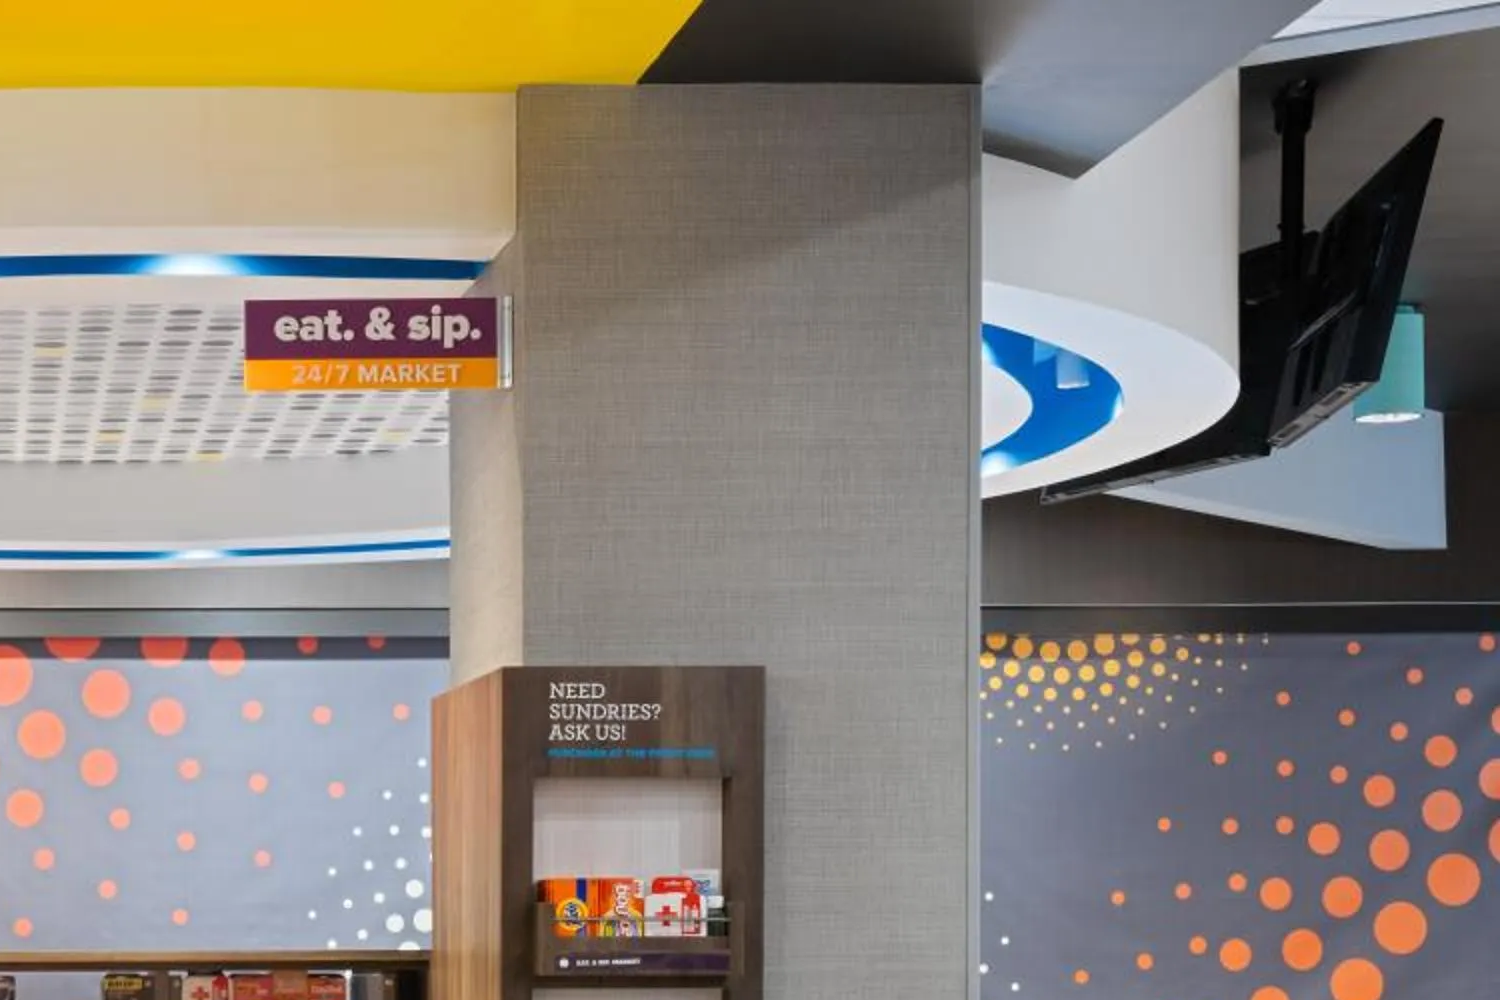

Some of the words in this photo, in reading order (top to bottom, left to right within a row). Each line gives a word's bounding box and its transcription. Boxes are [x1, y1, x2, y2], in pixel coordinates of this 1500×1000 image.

[274, 309, 355, 341] eat.
[365, 306, 395, 341] &
[407, 304, 482, 348] sip.
[292, 364, 351, 385] 24/7
[357, 363, 462, 384] MARKET
[549, 682, 606, 700] NEED
[549, 703, 662, 721] SUNDRIES?
[548, 724, 591, 741] ASK
[595, 724, 627, 741] US!
